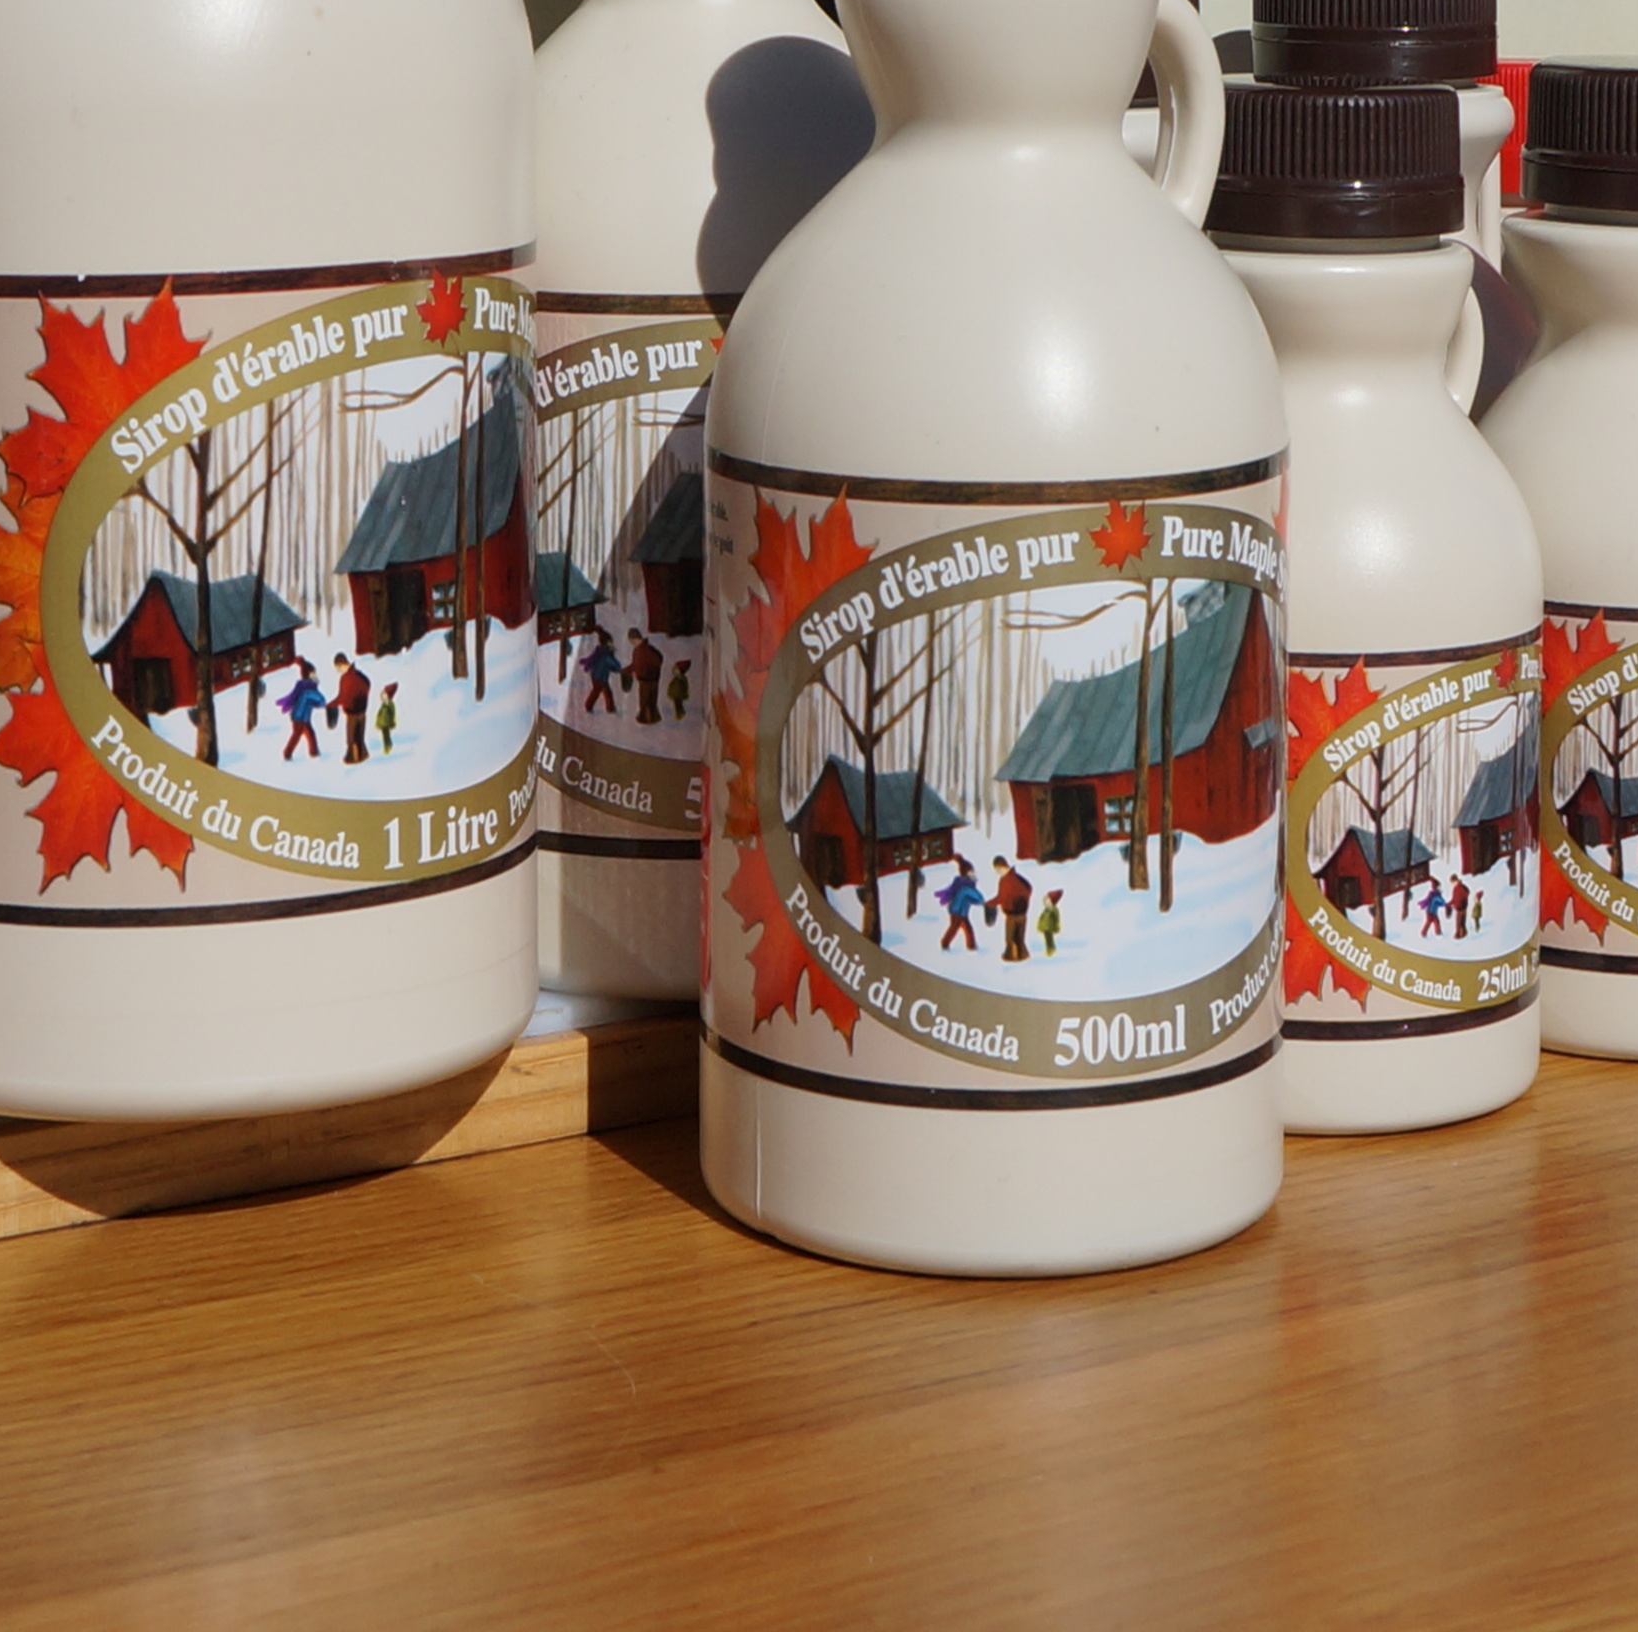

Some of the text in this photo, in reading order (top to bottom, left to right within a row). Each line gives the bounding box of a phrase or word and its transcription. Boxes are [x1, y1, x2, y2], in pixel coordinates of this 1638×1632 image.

[109, 392, 208, 474] Sirop
[212, 315, 345, 403] d'érable
[352, 301, 408, 358] pur
[473, 287, 516, 334] Pure
[646, 336, 702, 383] pur
[799, 591, 877, 664] Sirop
[877, 536, 1010, 611] d'érable
[1015, 530, 1080, 580] pur
[1160, 516, 1224, 560] Pure
[1227, 521, 1277, 582] Maple
[1323, 668, 1493, 773] Sirop d'érable pur
[1566, 669, 1621, 716] Sirop
[91, 716, 498, 870] Produit du Canada 1 Litre
[562, 754, 654, 815] Canada
[1553, 840, 1609, 909] Produit
[1611, 897, 1635, 923] du
[784, 883, 1269, 1068] Produit du Canada 500ml Product
[1307, 906, 1529, 1003] Produit du Canada 250ml
